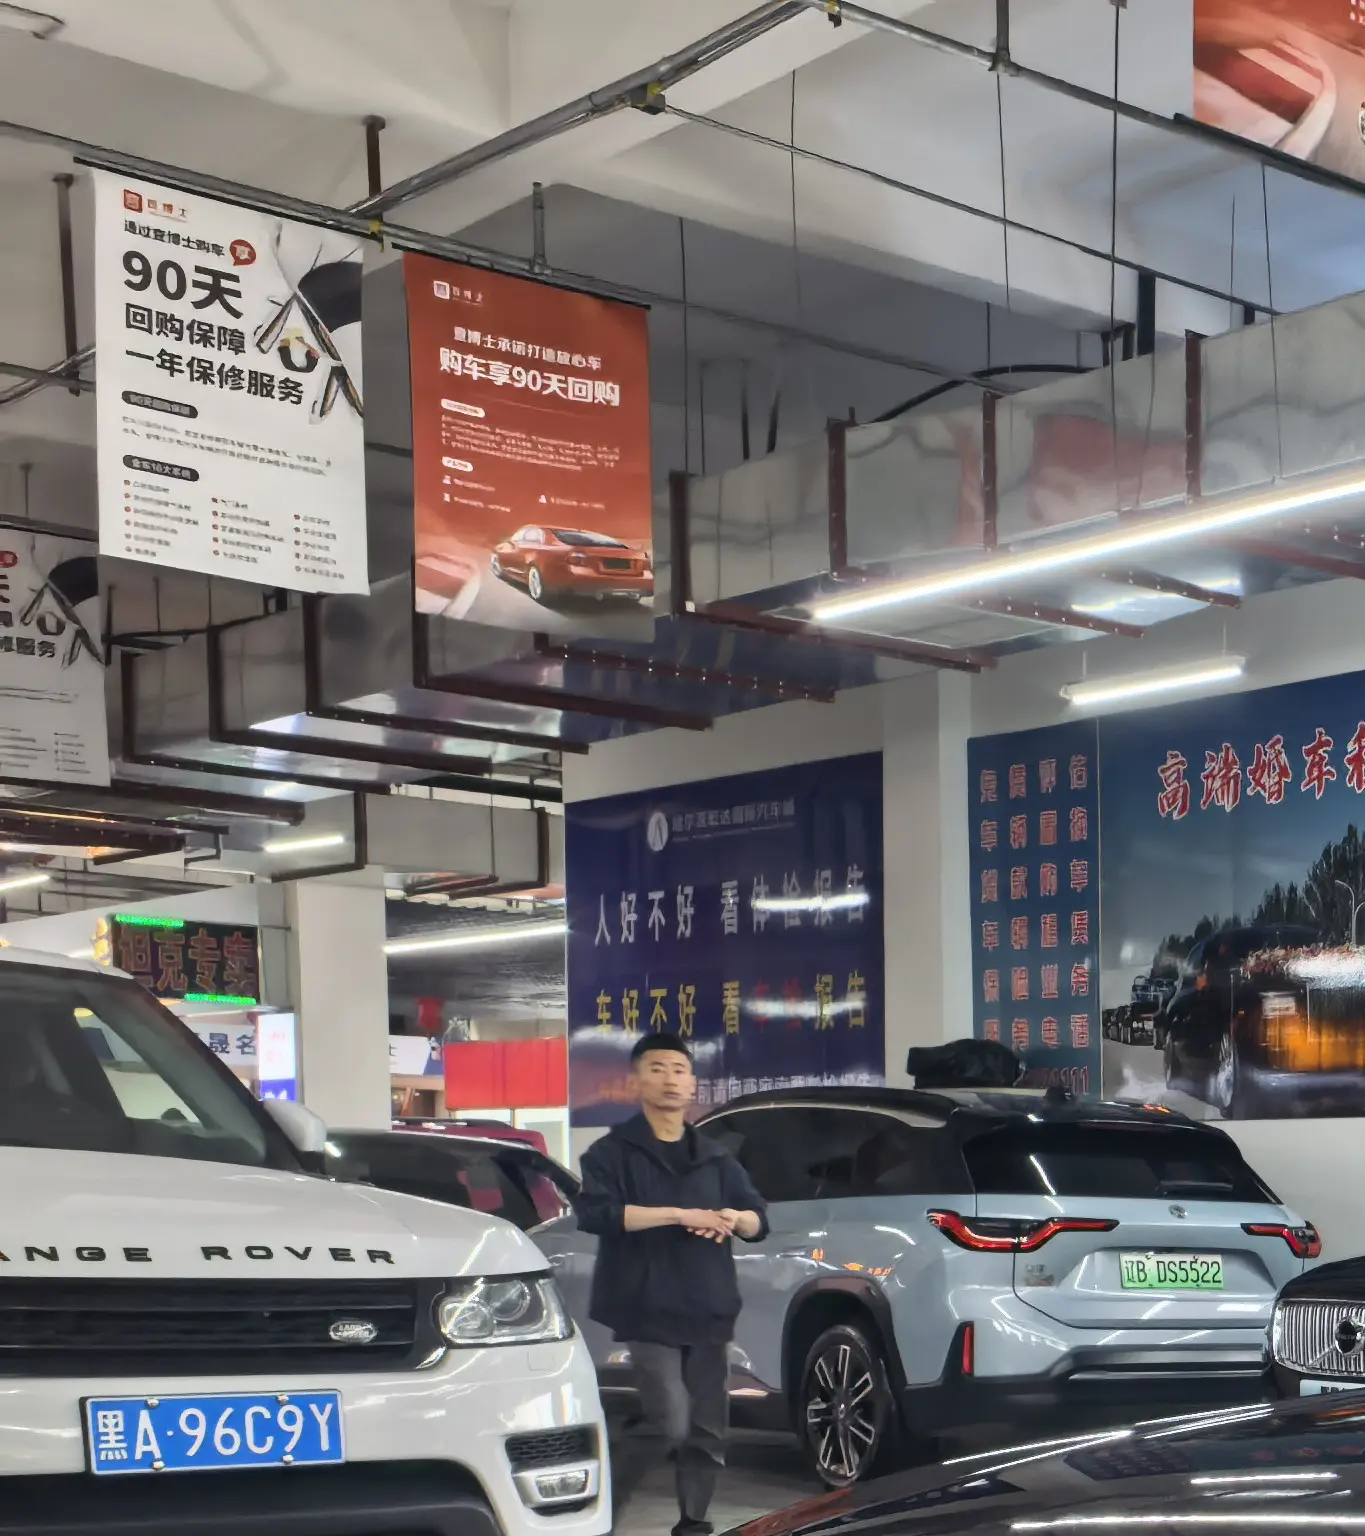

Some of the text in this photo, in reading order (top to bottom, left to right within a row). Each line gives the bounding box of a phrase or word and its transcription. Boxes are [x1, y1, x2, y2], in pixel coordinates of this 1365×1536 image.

[122, 250, 244, 320] 90天
[125, 302, 247, 356] 回购保障
[125, 348, 304, 405] 一年保修服务
[439, 347, 620, 407] 购车享90天回购
[594, 884, 695, 946] 人好不好
[596, 983, 696, 1037] 车好不好
[201, 1245, 396, 1264] ROVER
